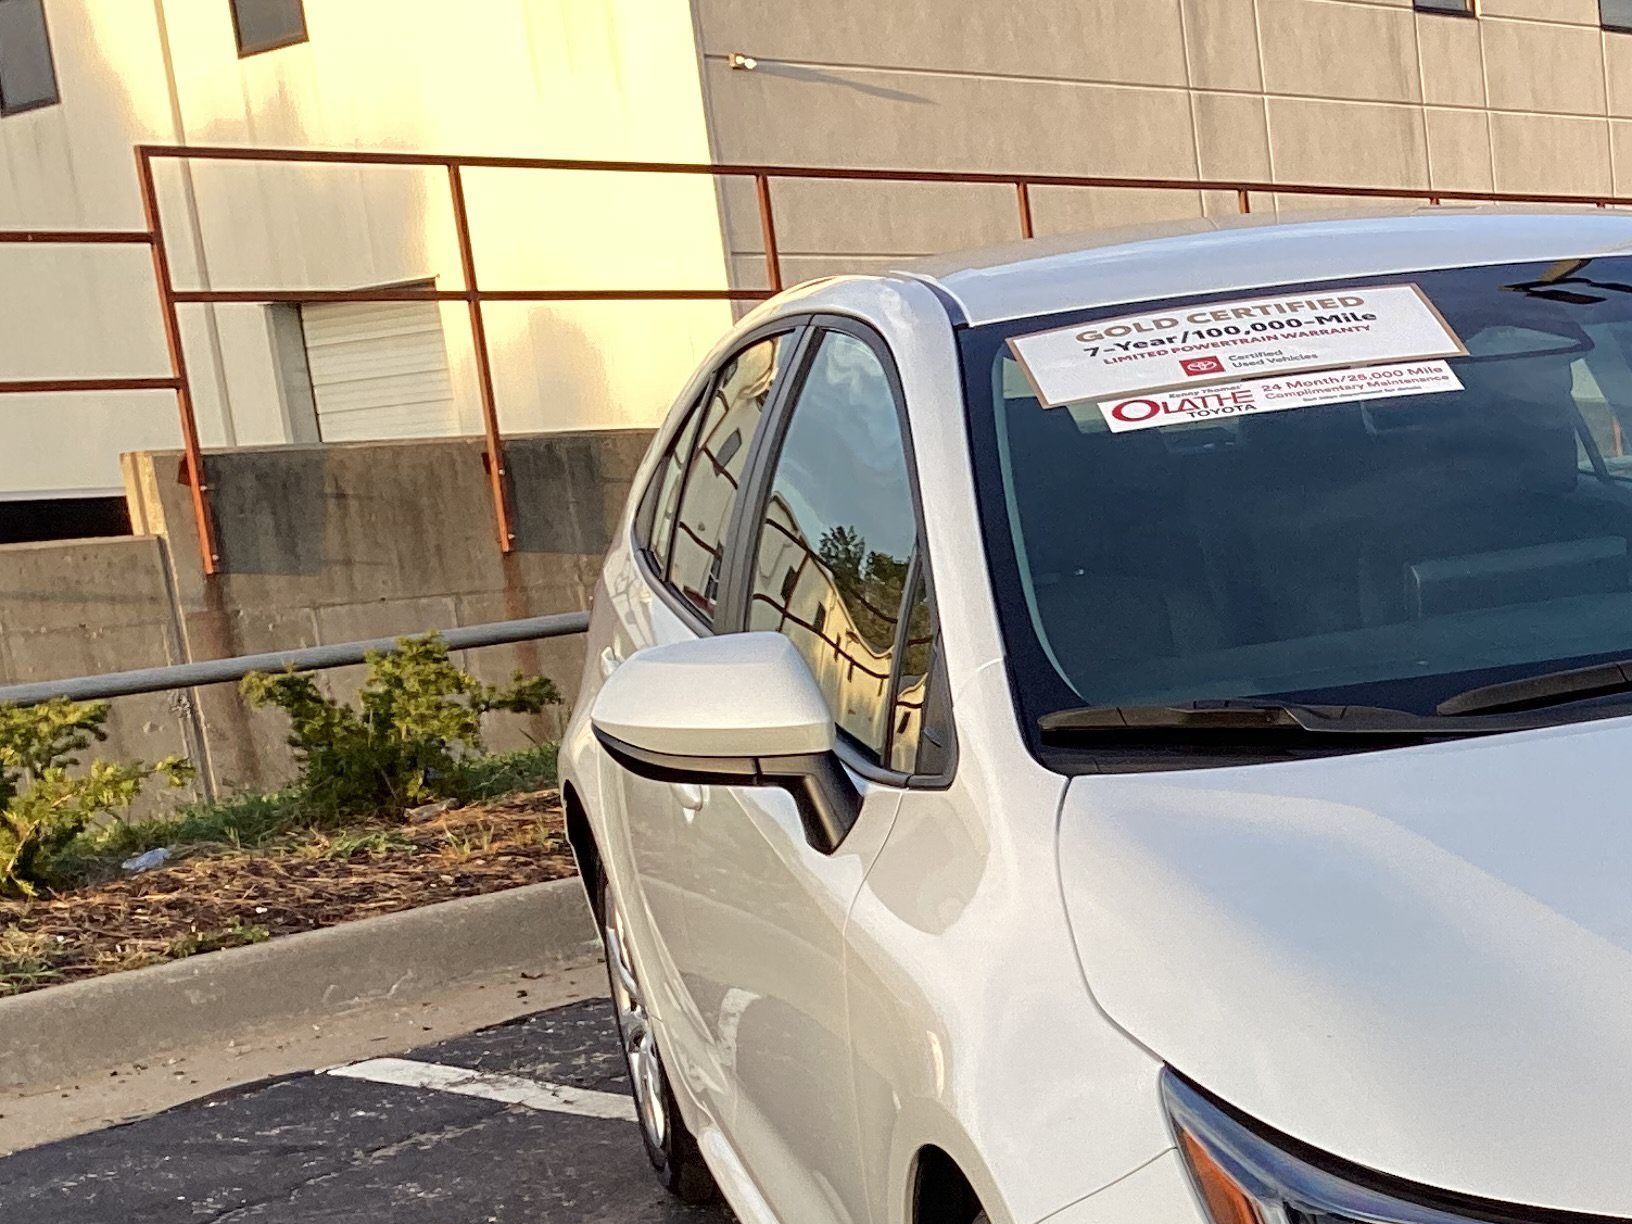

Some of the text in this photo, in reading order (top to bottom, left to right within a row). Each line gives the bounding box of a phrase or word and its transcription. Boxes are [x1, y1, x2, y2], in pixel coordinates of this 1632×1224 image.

[1076, 296, 1365, 342] GOLD CERTIFIED
[1084, 312, 1377, 357] 7-Year/100,000-Mile
[1104, 325, 1371, 365] LIMITED POWERTRAIN WARRANTY
[1228, 350, 1283, 361] Certified
[1232, 352, 1318, 368] Used Vehicles
[1261, 383, 1282, 392] 24
[1407, 366, 1443, 376] Mile
[1265, 384, 1364, 400] Complimentary
[1367, 375, 1449, 388] Maintenance
[1111, 390, 1255, 422] OLATHE
[1187, 404, 1257, 418] TOYOTA
